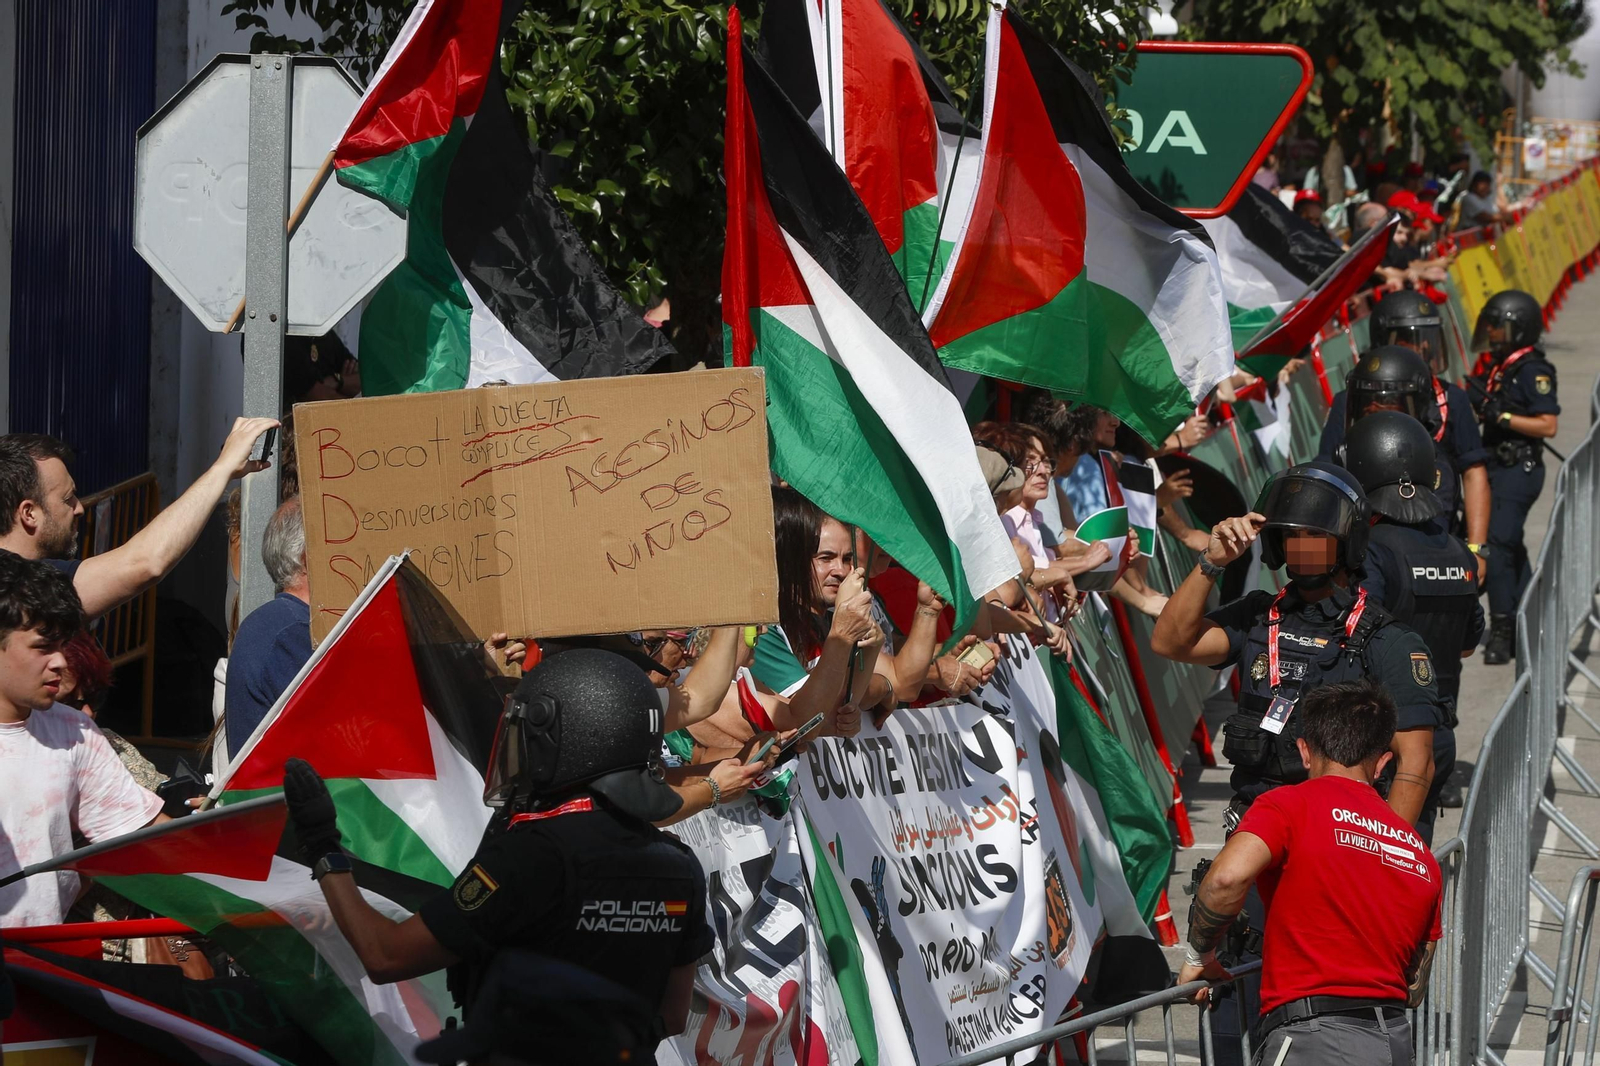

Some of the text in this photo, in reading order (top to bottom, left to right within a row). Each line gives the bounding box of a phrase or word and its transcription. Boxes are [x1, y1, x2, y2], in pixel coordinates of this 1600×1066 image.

[463, 396, 573, 436] LA VUELTA
[640, 472, 704, 513] DE
[1412, 567, 1467, 580] POLICIA
[1332, 808, 1425, 854] ORGANIZACIÓN
[1340, 832, 1351, 844] LA
[1351, 834, 1379, 852] VUELTA
[581, 901, 667, 915] POLICIA
[576, 917, 682, 932] NACIONAL
[919, 941, 939, 983] DO
